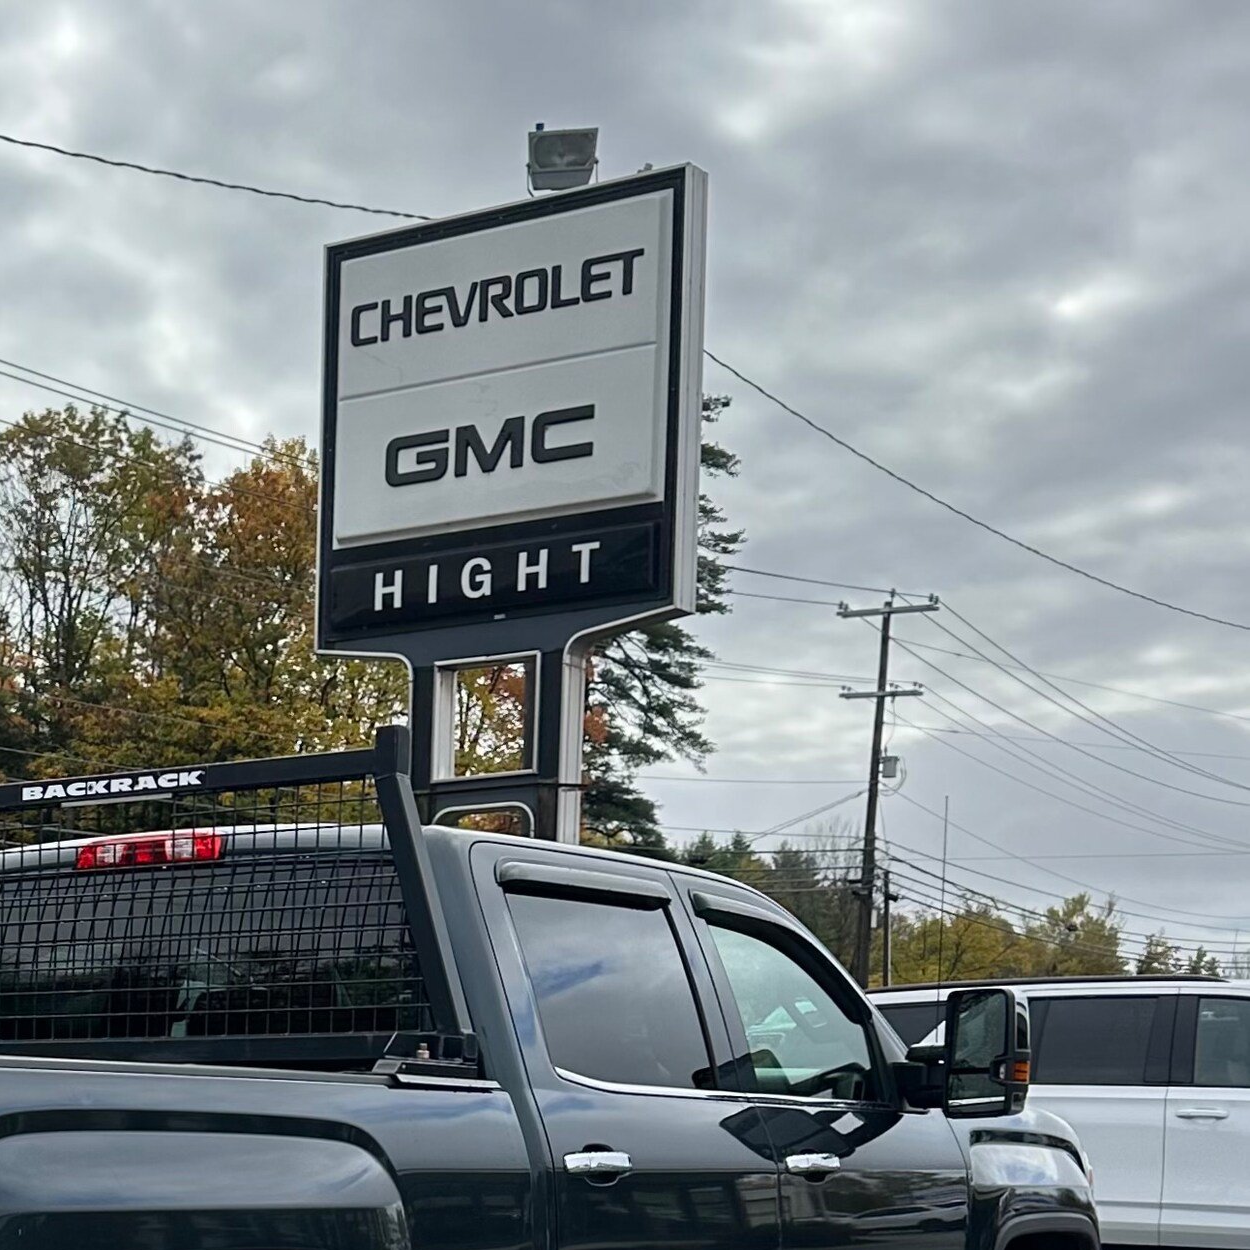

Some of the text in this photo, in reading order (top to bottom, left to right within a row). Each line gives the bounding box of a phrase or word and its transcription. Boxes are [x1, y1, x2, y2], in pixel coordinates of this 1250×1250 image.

[350, 247, 645, 347] CHEVROLET
[384, 403, 596, 488] GMC
[373, 540, 602, 612] HIGHT
[21, 770, 203, 801] BACKRACK
